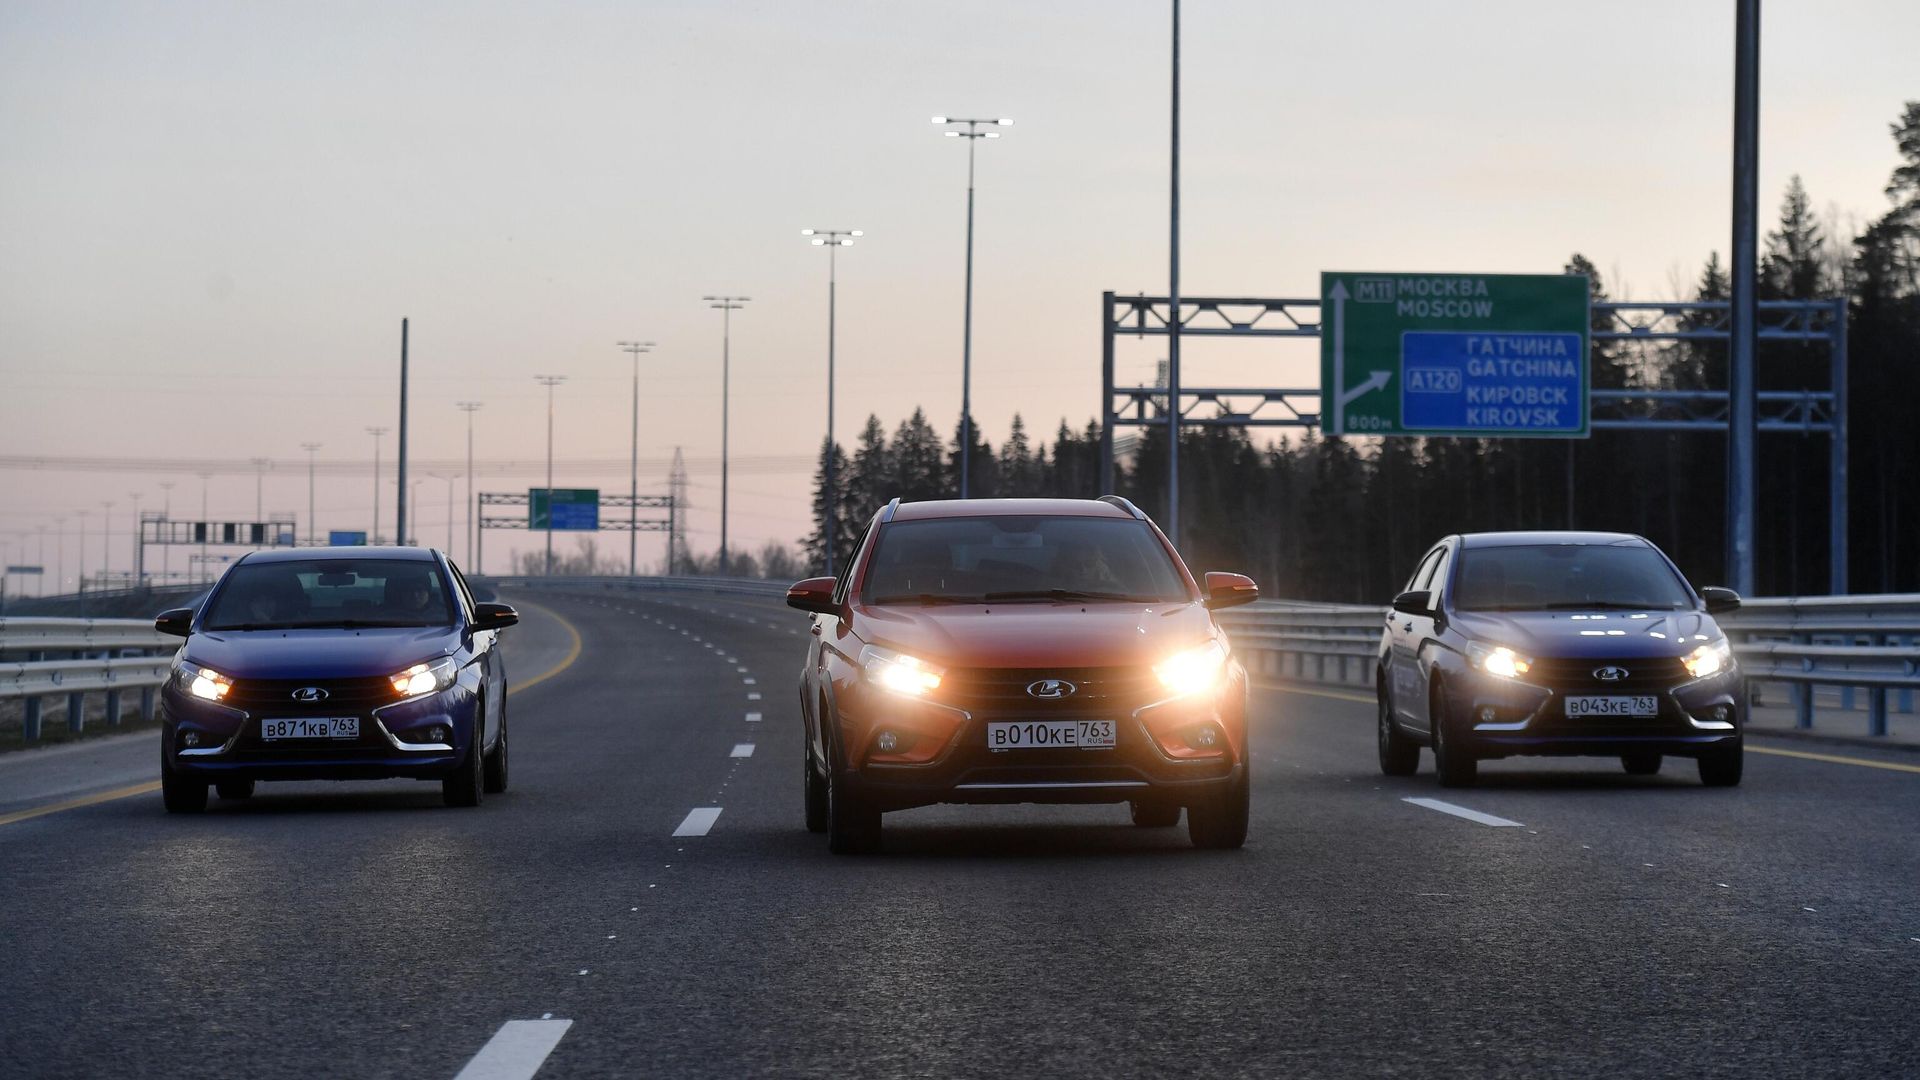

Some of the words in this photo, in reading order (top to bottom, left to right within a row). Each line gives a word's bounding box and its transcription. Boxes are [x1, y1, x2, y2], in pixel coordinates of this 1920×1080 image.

[1359, 281, 1392, 299] М11
[1398, 278, 1488, 297] МОСКВА
[1398, 300, 1493, 318] MOSCOW
[1467, 337, 1567, 356] ГАТЧИНА
[1467, 359, 1577, 378] GATCHINA
[1411, 373, 1459, 390] А120
[1467, 387, 1568, 406] КИРОВСК
[1467, 408, 1560, 427] KIROVSK
[1632, 698, 1653, 709] 763
[332, 719, 354, 731] 763
[1079, 722, 1110, 737] 763
